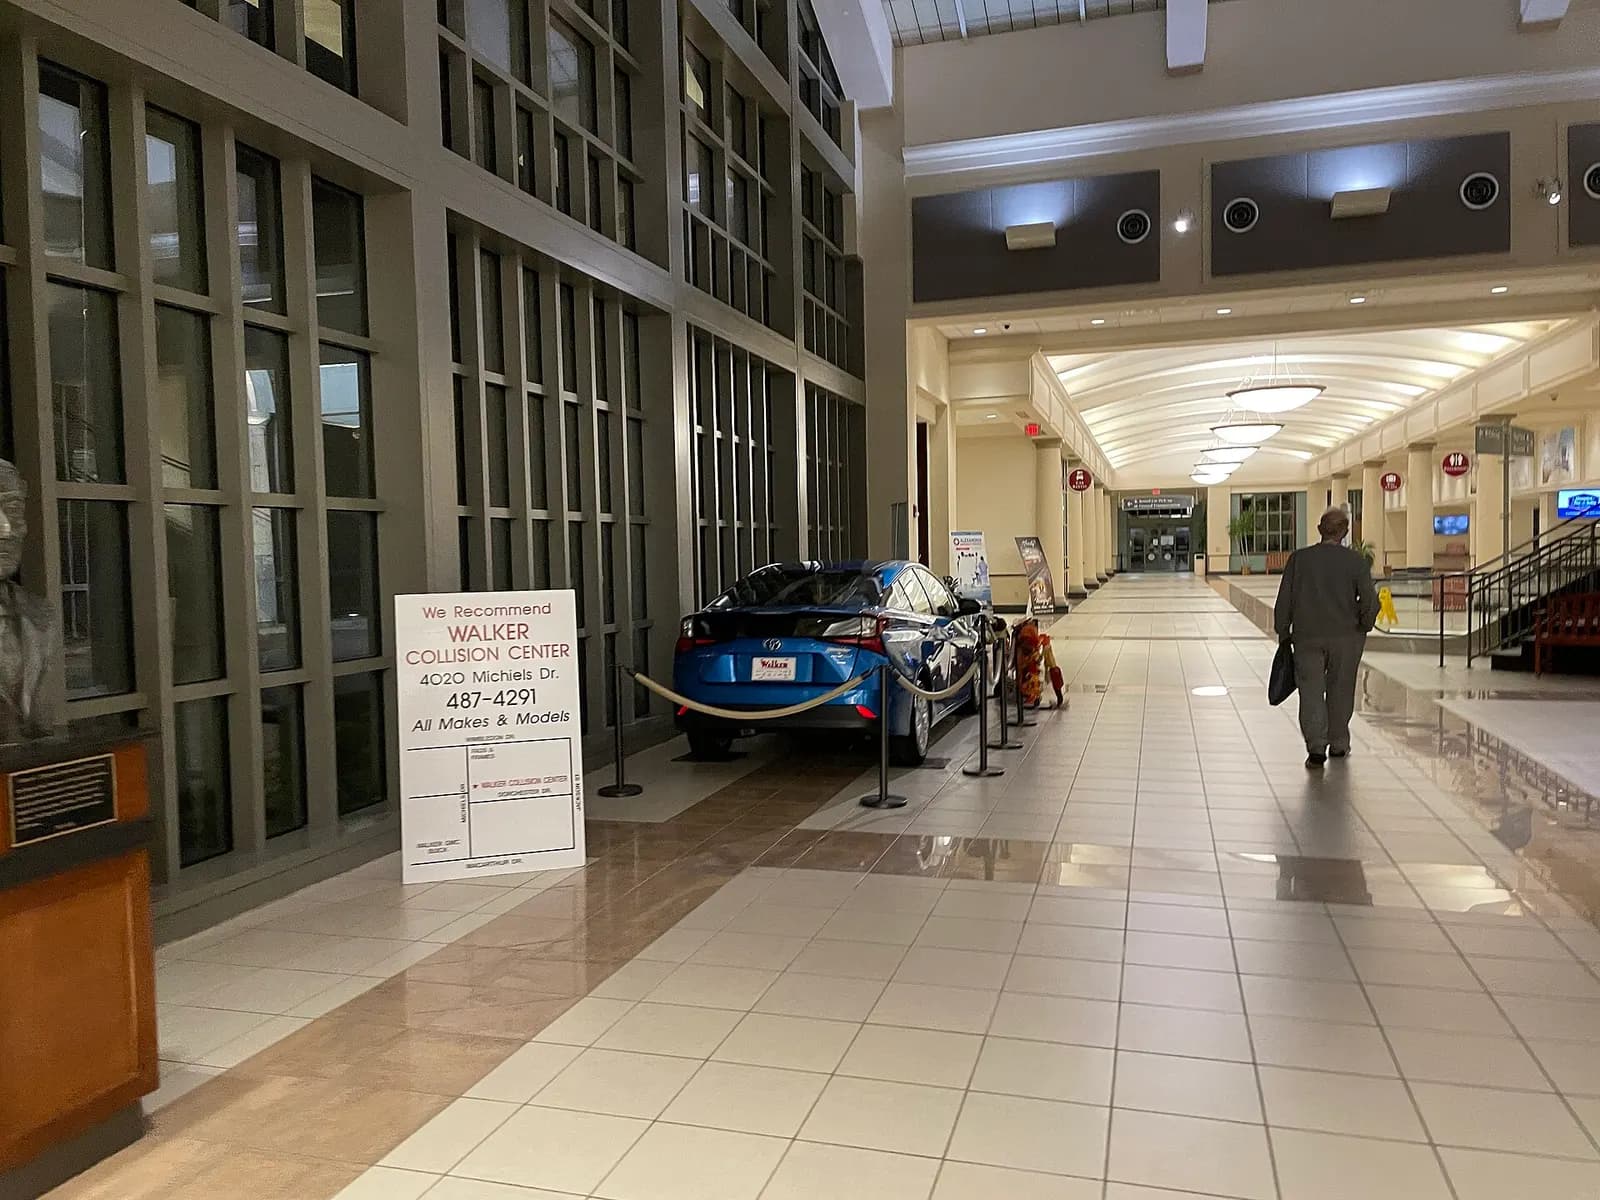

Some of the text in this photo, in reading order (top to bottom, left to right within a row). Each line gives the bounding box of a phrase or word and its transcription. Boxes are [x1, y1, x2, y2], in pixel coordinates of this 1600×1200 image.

[422, 602, 552, 618] We Recommend
[448, 623, 529, 642] WALKER
[406, 643, 570, 665] COLLISION CENTER
[420, 668, 560, 686] 4020 Michiels Dr.
[446, 688, 536, 710] 487-4291
[412, 710, 570, 732] All Makes & Models
[508, 778, 542, 786] COLLISION
